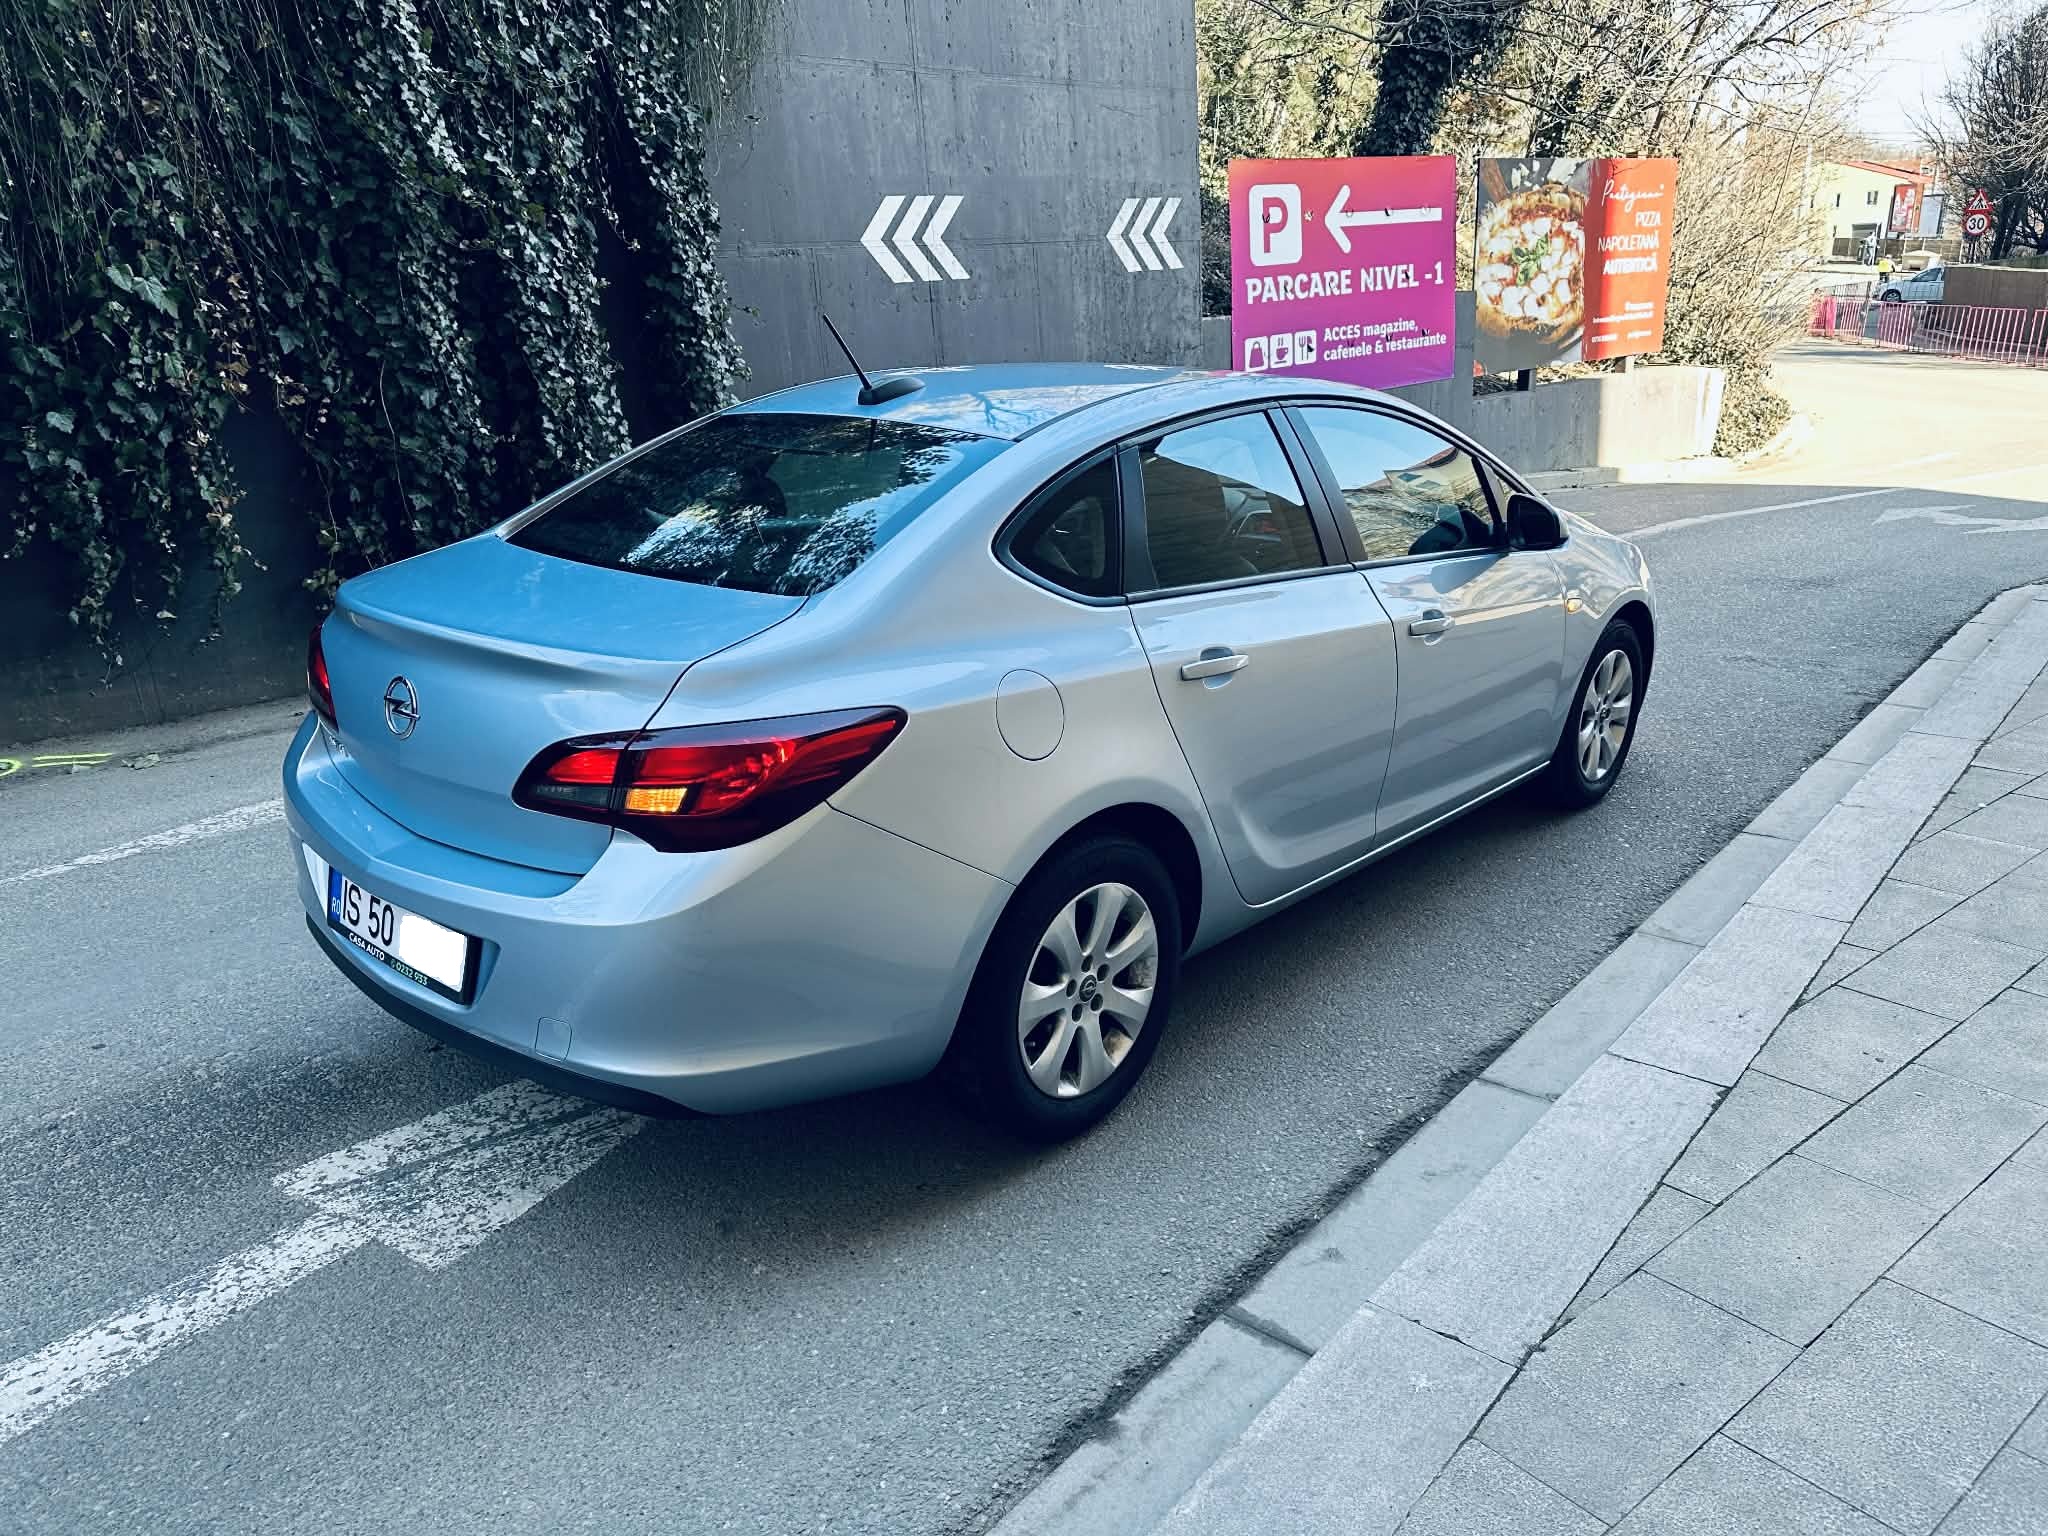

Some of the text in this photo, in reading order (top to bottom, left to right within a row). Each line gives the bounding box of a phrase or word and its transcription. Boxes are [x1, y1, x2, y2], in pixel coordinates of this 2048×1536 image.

[1263, 196, 1288, 254] P
[1635, 210, 1661, 228] PIZZA
[1968, 218, 1984, 230] 30
[1245, 261, 1444, 304] PARCARE NIVEL -1
[1323, 317, 1418, 342] ACCES magazine,
[1323, 331, 1447, 361] cafenele & restaurante
[331, 897, 341, 914] RO
[342, 879, 394, 947] IS 50
[349, 933, 384, 960] CASA AUTO
[395, 961, 414, 978] 0232
